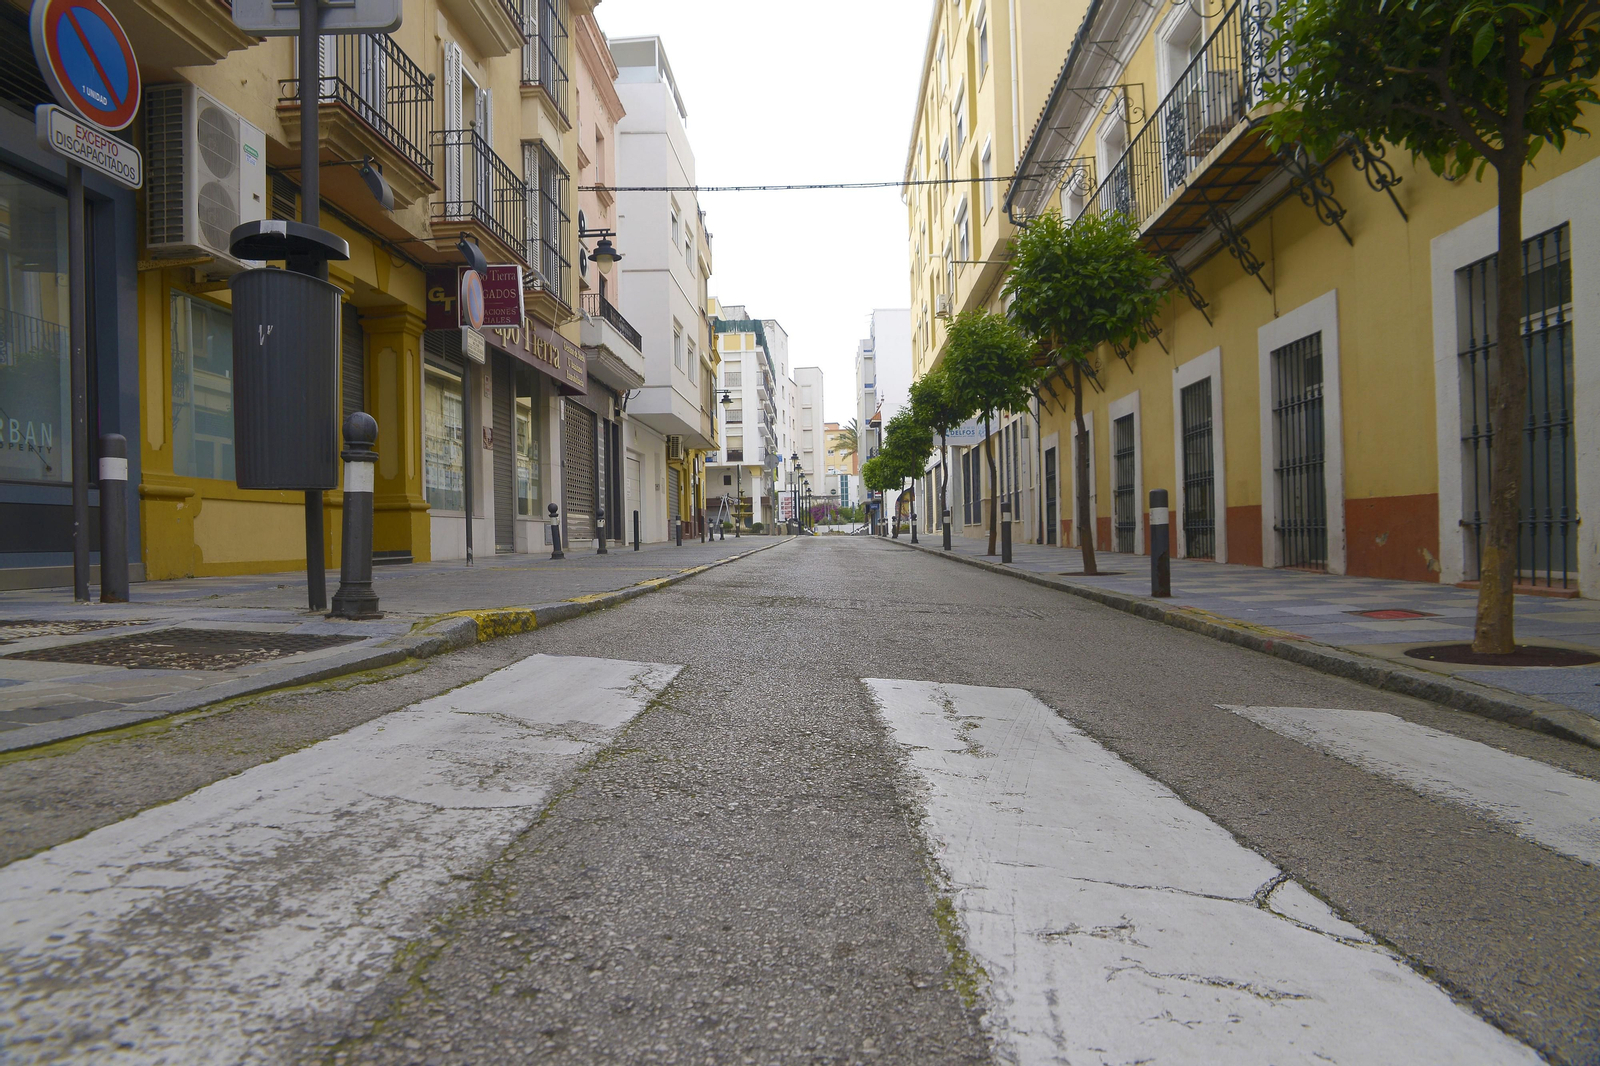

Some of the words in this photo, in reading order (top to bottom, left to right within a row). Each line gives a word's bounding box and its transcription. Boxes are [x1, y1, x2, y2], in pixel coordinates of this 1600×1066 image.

[82, 85, 86, 93] 1
[87, 86, 108, 106] UNIDAD
[75, 124, 119, 157] EXCEPTO
[55, 131, 136, 180] DISCAPACITADOS
[490, 270, 516, 281] Tierra
[483, 289, 517, 299] GADOS
[524, 315, 561, 370] Tierra
